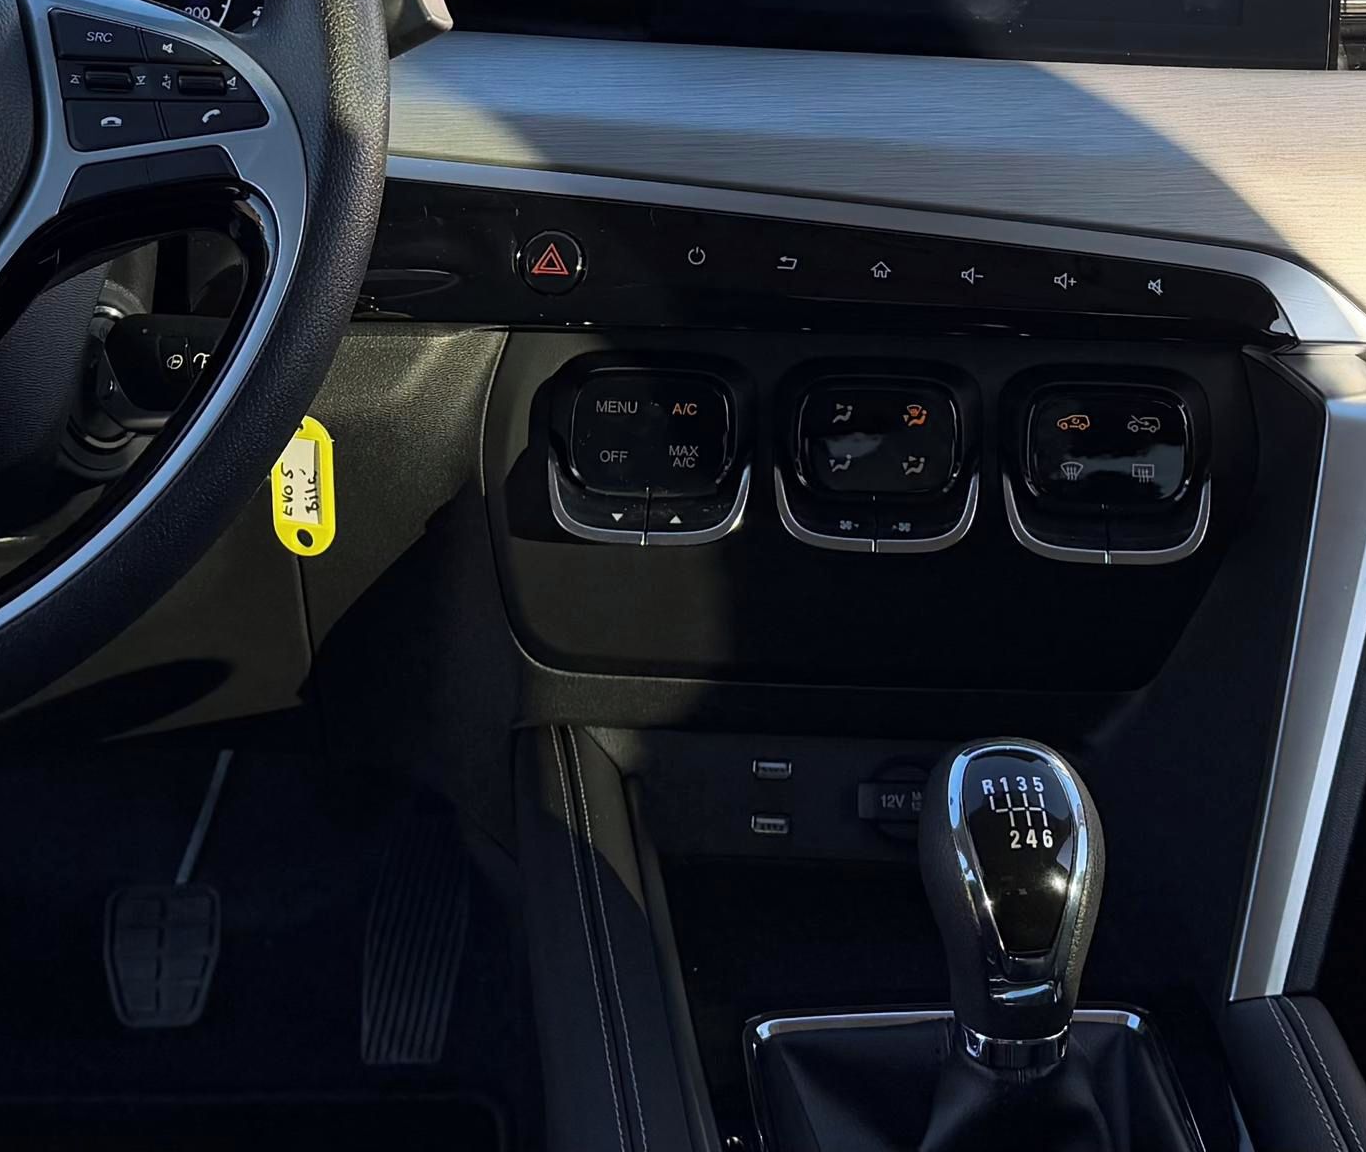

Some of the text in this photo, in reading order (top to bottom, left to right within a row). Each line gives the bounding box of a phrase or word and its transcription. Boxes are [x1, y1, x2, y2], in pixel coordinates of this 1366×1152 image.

[86, 31, 113, 43] SRC
[596, 400, 638, 414] MENU
[672, 403, 697, 416] A/C
[599, 450, 629, 463] OFF
[669, 445, 699, 457] MAX
[673, 457, 696, 468] A/C
[281, 485, 293, 516] EVO
[981, 776, 1044, 795] R 1 3 5
[881, 794, 905, 808] 12V
[1009, 829, 1053, 849] 2 4 6
